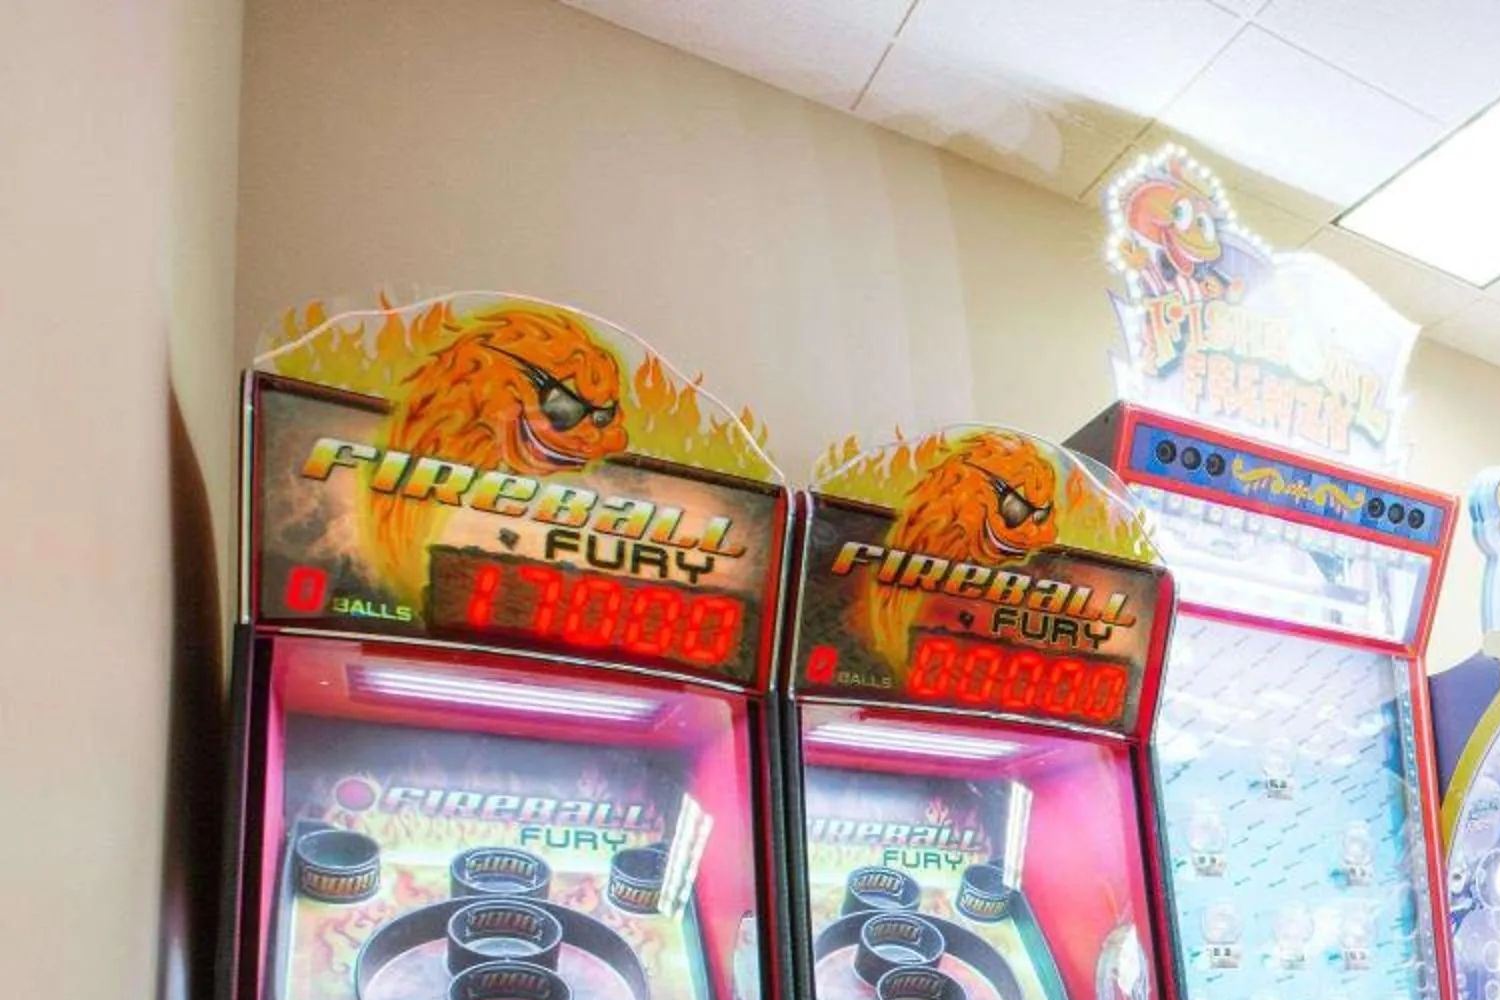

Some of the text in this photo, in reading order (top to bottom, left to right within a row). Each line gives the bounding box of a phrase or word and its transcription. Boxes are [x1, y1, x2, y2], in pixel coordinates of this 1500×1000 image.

[546, 530, 714, 584] FURY
[285, 566, 327, 612] 0
[333, 597, 413, 623] BALLS
[992, 608, 1113, 650] FURY
[520, 826, 629, 852] FURY
[883, 847, 965, 871] FURY
